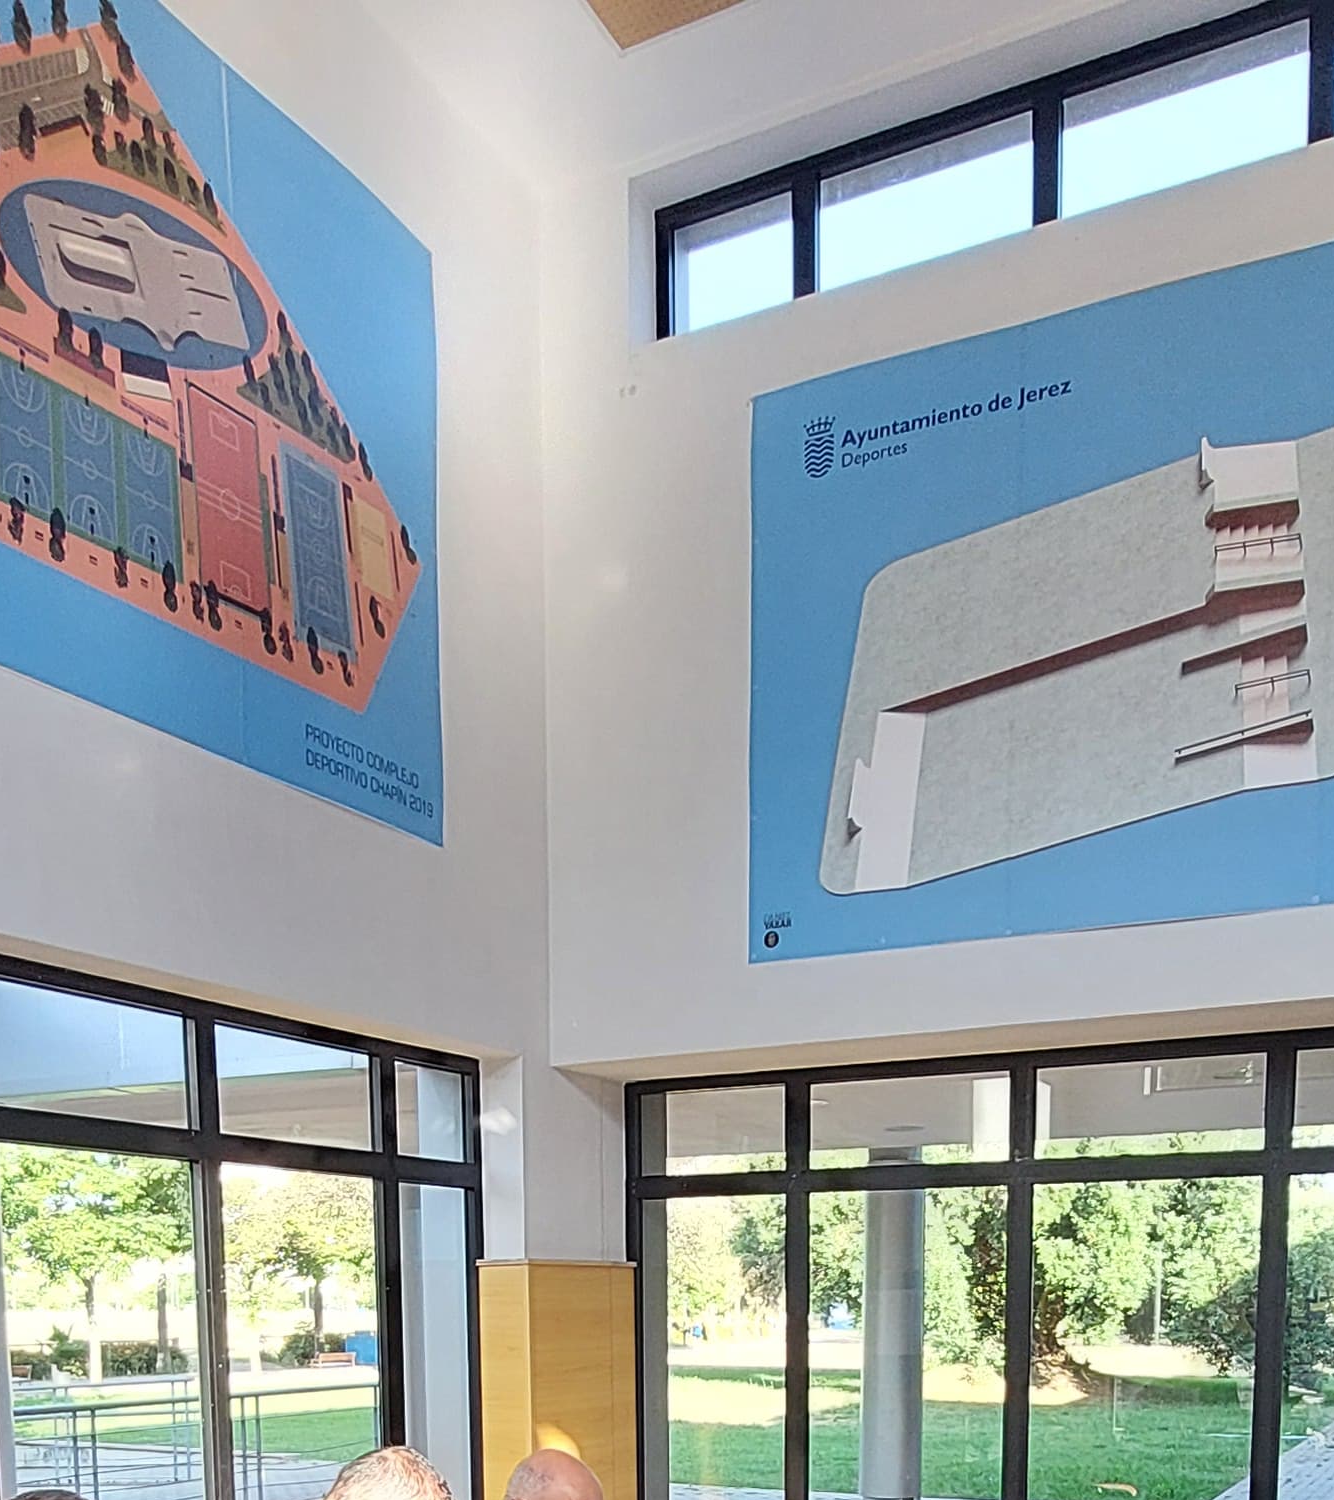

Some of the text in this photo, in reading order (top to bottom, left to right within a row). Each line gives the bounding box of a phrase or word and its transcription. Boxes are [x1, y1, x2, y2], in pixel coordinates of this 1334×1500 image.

[840, 379, 1073, 450] Ayuntamiento de Jerez
[841, 441, 909, 469] Deportes
[305, 723, 419, 789] PROYECTO COMPLEJO
[305, 748, 367, 789] DEPORTIVO
[409, 794, 434, 818] 2019
